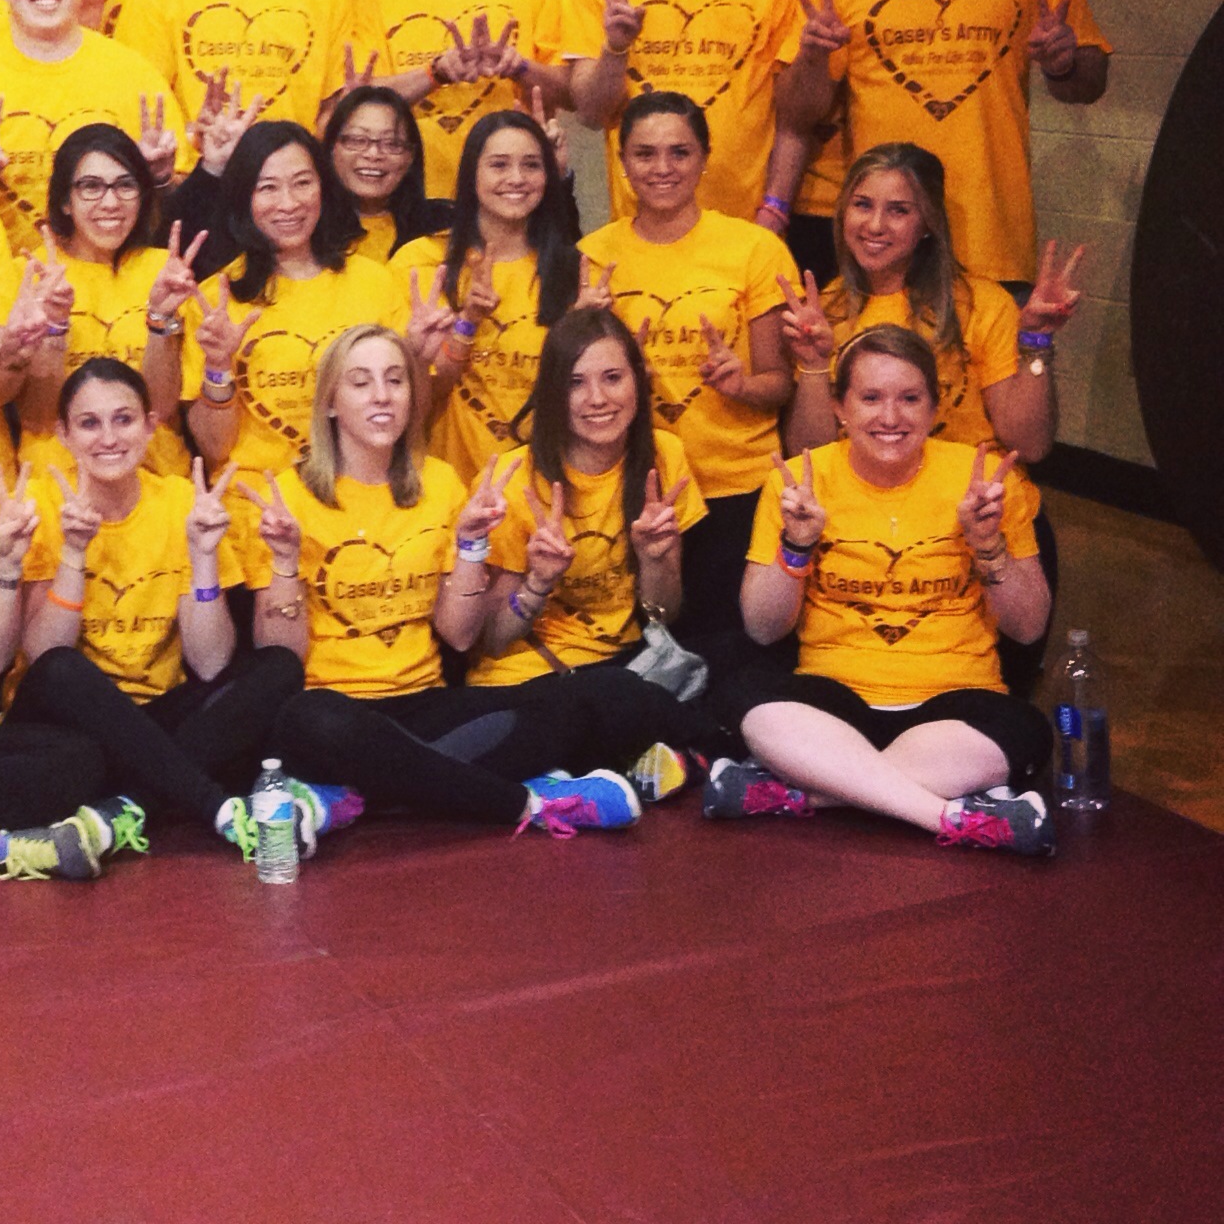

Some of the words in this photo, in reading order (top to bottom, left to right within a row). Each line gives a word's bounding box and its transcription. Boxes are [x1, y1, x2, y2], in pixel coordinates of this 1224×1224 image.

[882, 26, 952, 47] Casey's
[956, 18, 1002, 47] Army
[632, 37, 694, 57] Casey's
[697, 38, 737, 60] Army
[825, 572, 903, 598] Casey's
[909, 574, 963, 596] Army
